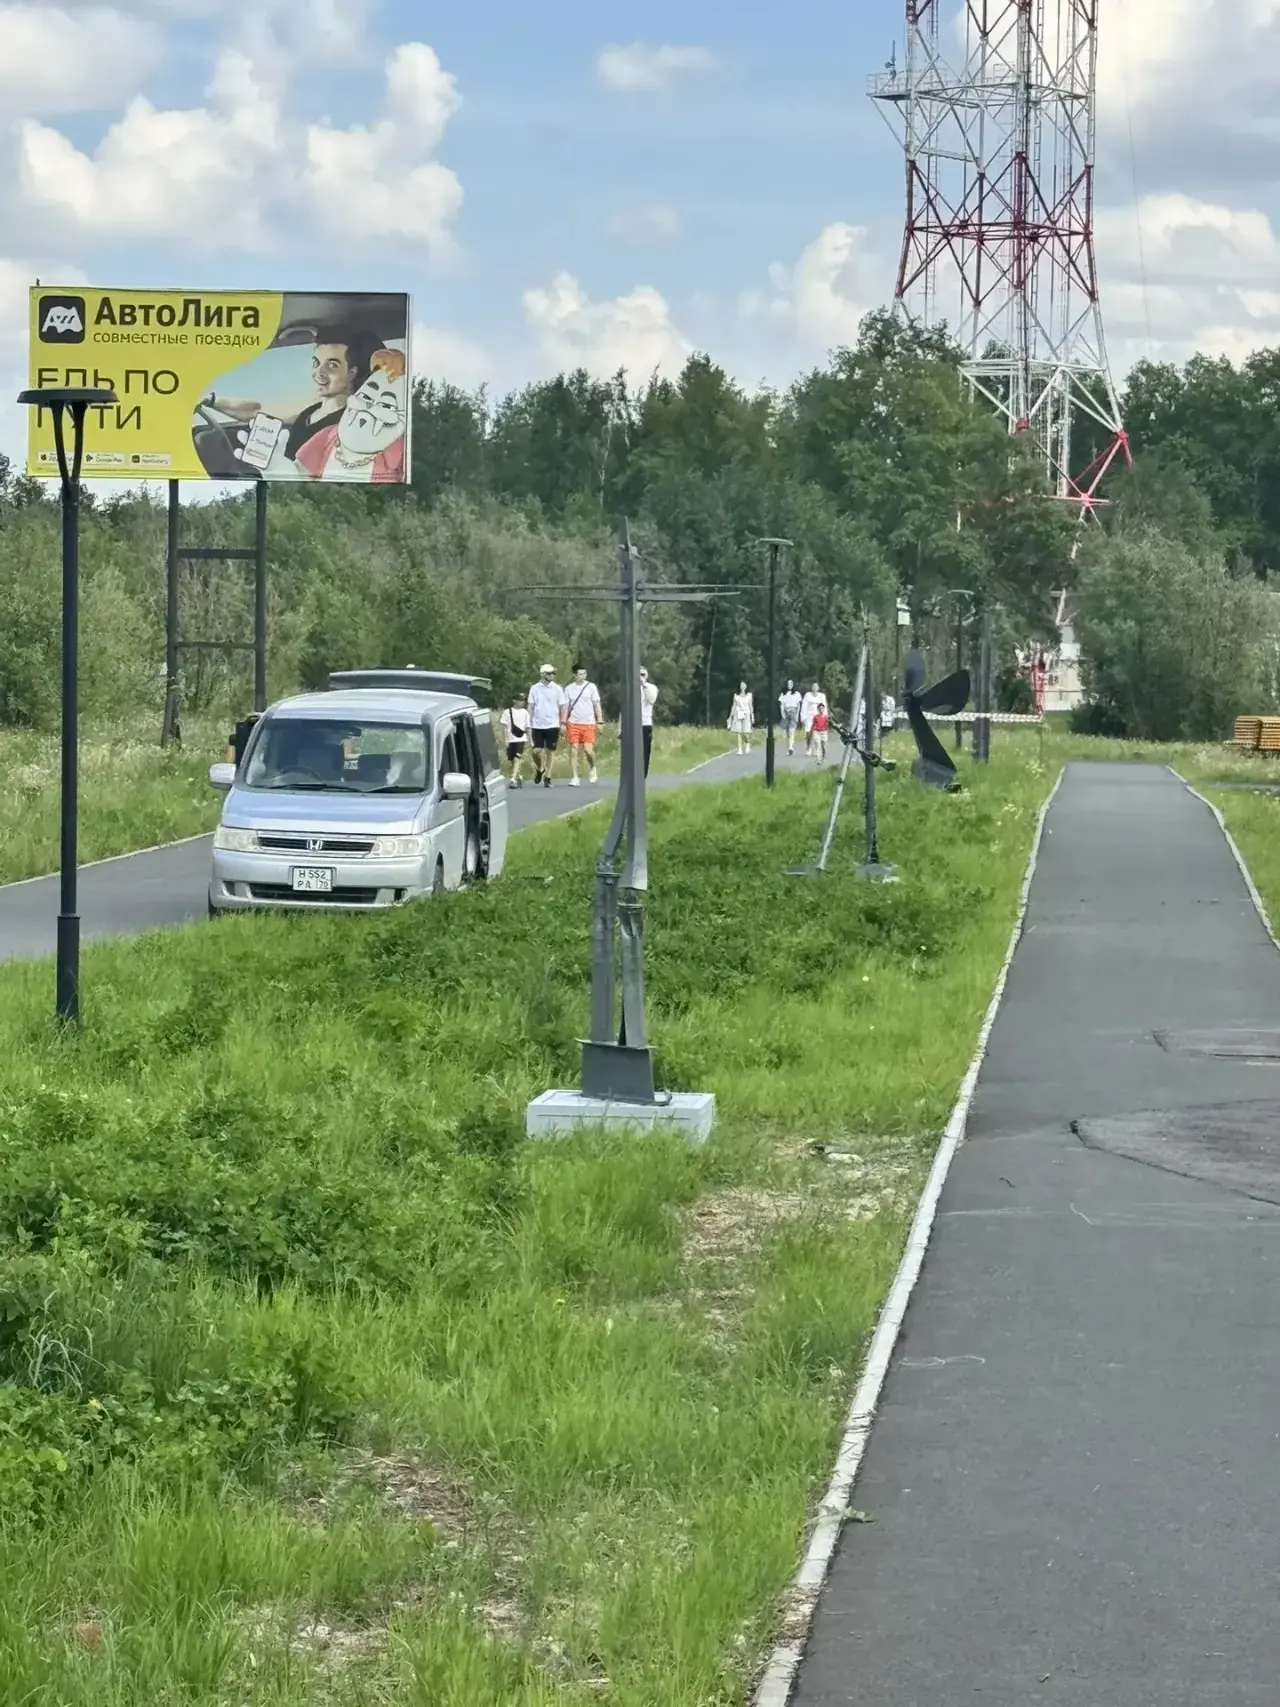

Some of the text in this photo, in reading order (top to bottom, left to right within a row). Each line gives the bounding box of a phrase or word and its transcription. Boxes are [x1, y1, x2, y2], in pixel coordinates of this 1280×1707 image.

[94, 297, 260, 328] АвтоЛига
[93, 332, 260, 348] совместные поездки
[124, 369, 180, 395] ПО
